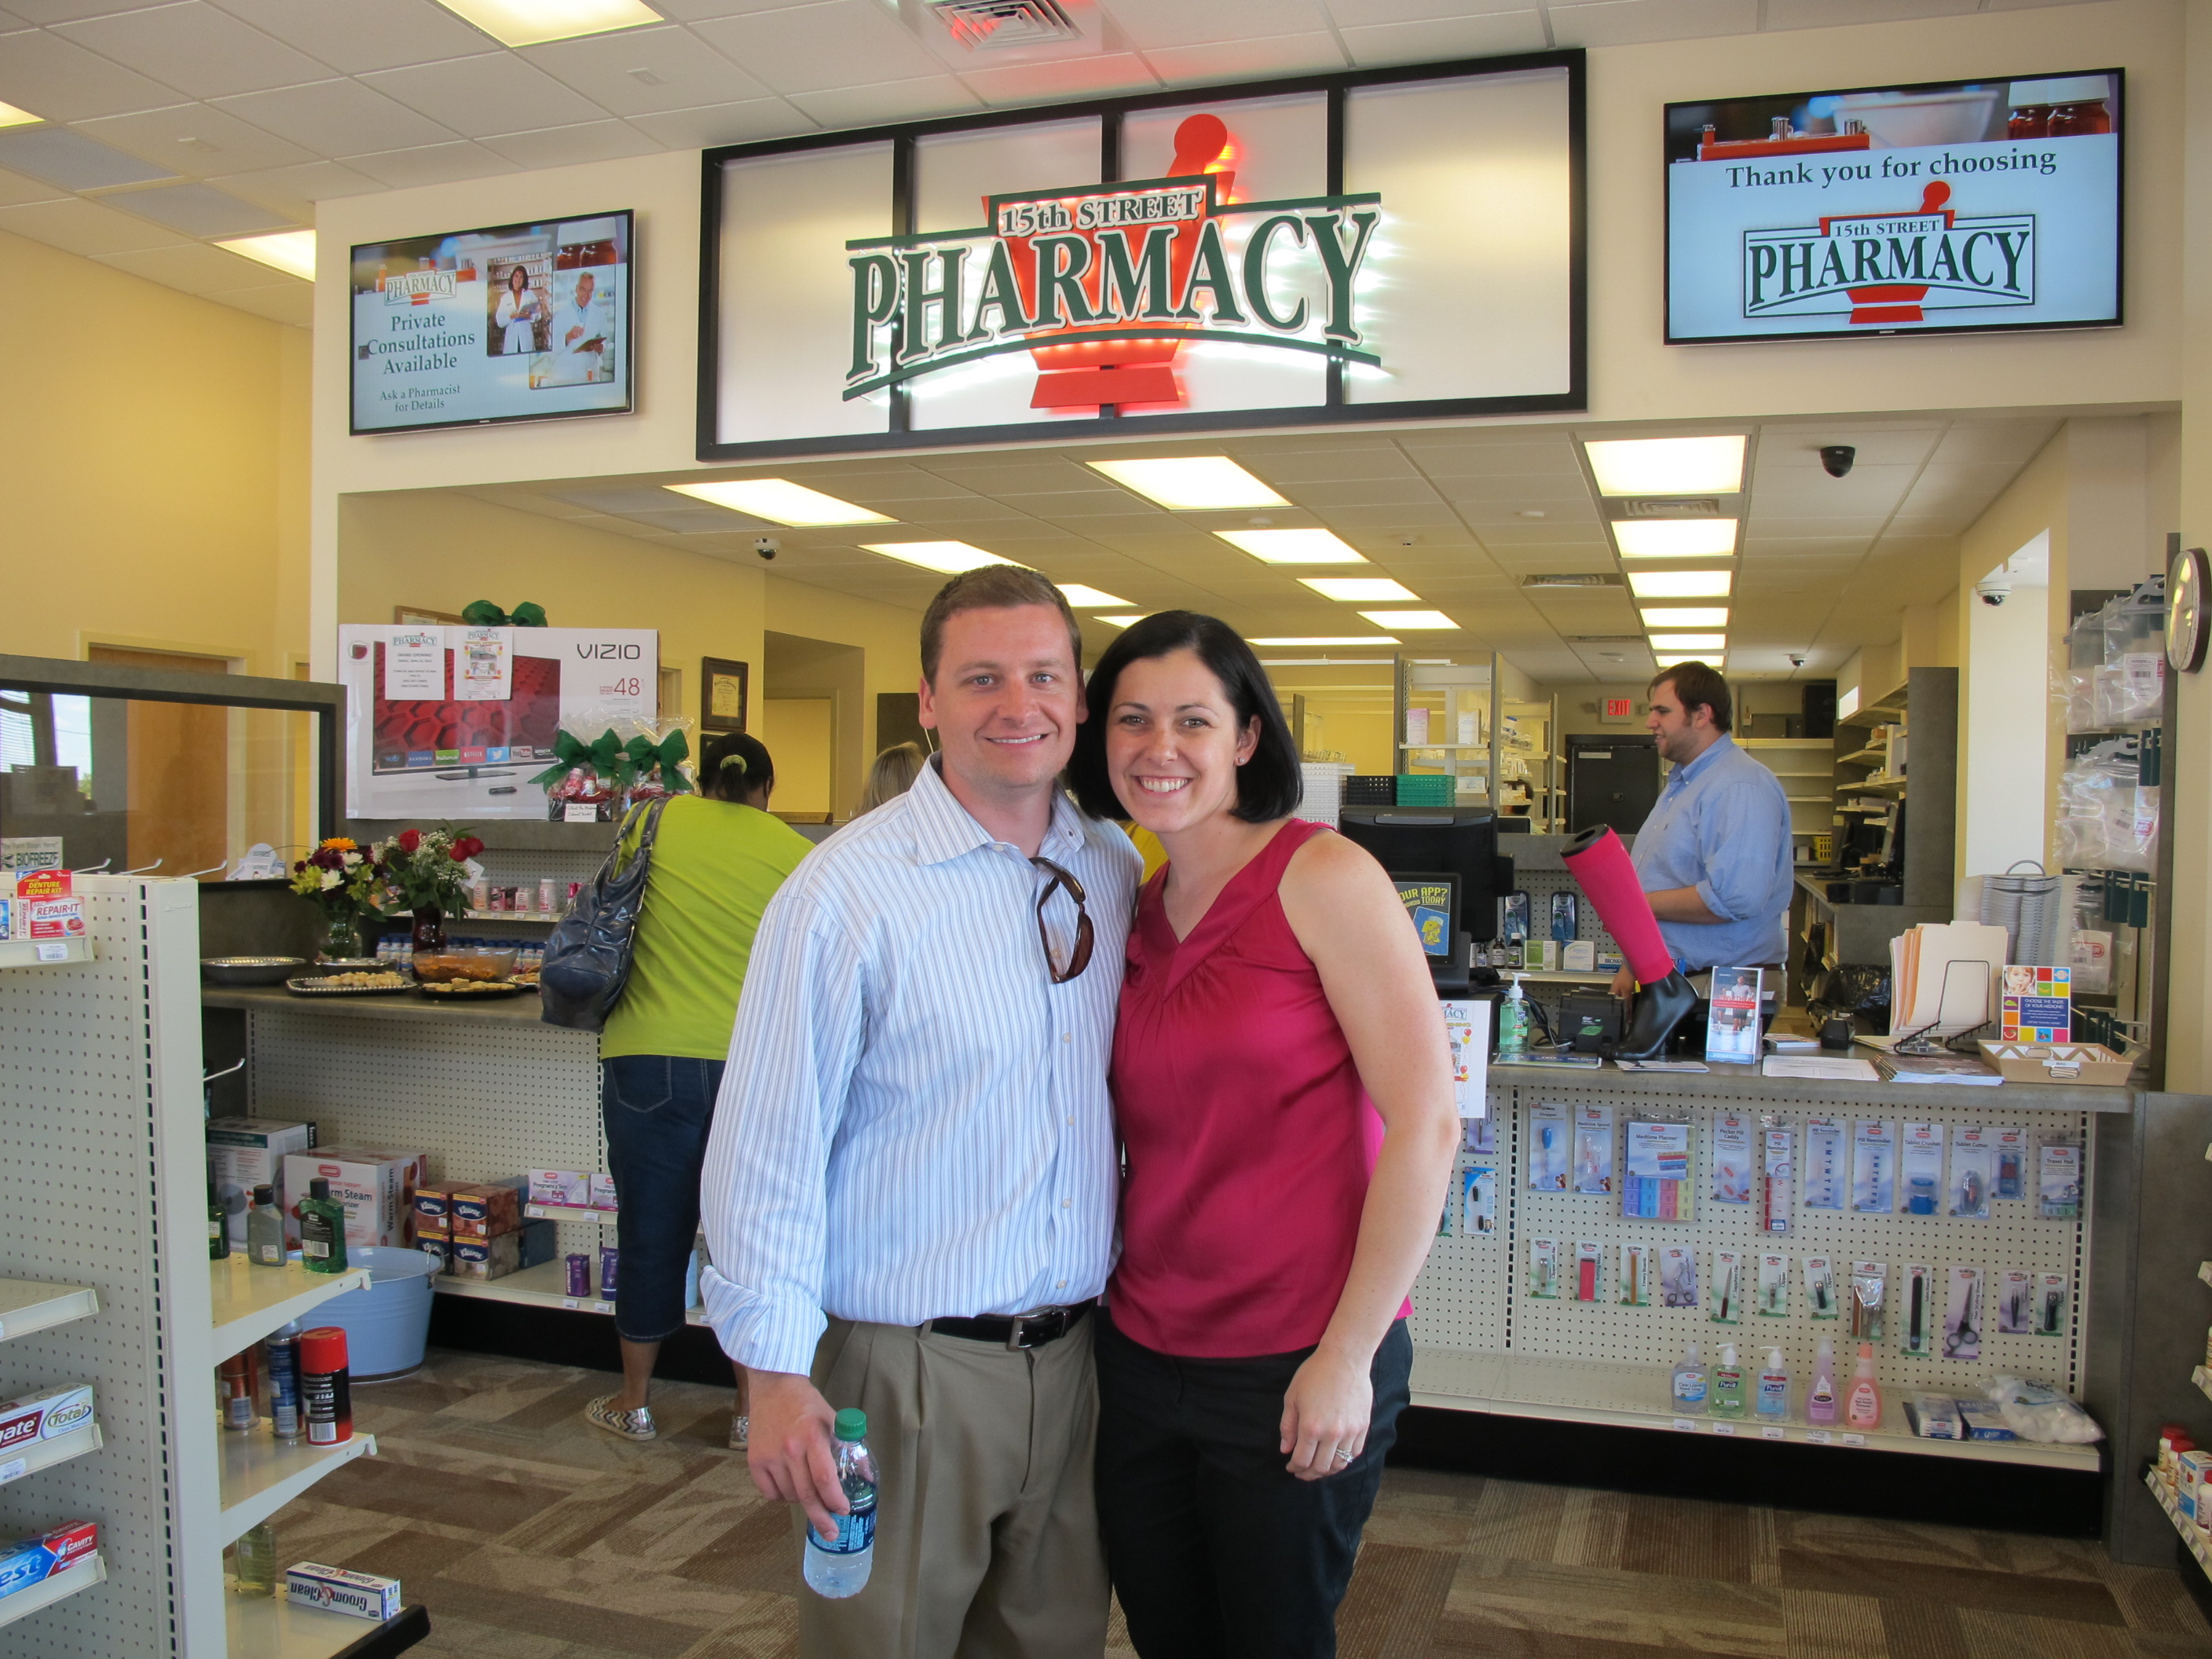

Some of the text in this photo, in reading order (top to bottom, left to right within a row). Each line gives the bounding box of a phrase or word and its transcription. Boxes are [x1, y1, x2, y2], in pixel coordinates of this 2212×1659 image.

[1726, 147, 2057, 189] Thank you for choosing
[1000, 185, 1205, 237] 15th STREET
[1834, 219, 1940, 238] 15th STREET
[1749, 231, 2030, 307] PHARMACY
[386, 274, 456, 301] PHARMACY
[846, 210, 1381, 383] PHARMACY
[390, 313, 445, 331] Private
[368, 331, 475, 355] Consultations
[383, 353, 457, 375] Available
[380, 390, 398, 401] Ask
[408, 385, 460, 398] Pharmacist
[394, 399, 445, 412] for Details
[394, 637, 437, 646] PHARMACY
[577, 643, 640, 659] VIZIO
[613, 677, 640, 696] 48
[1608, 699, 1632, 716] EXIT
[16, 851, 59, 866] BIOFREEZE
[1399, 887, 1448, 901] OUR APP?
[1421, 896, 1446, 905] TODAY
[329, 1189, 372, 1202] rm Steam
[50, 1404, 87, 1426] Total
[68, 1536, 93, 1551] CAVITY
[290, 1581, 320, 1602] Clean
[332, 1591, 368, 1612] Groom
